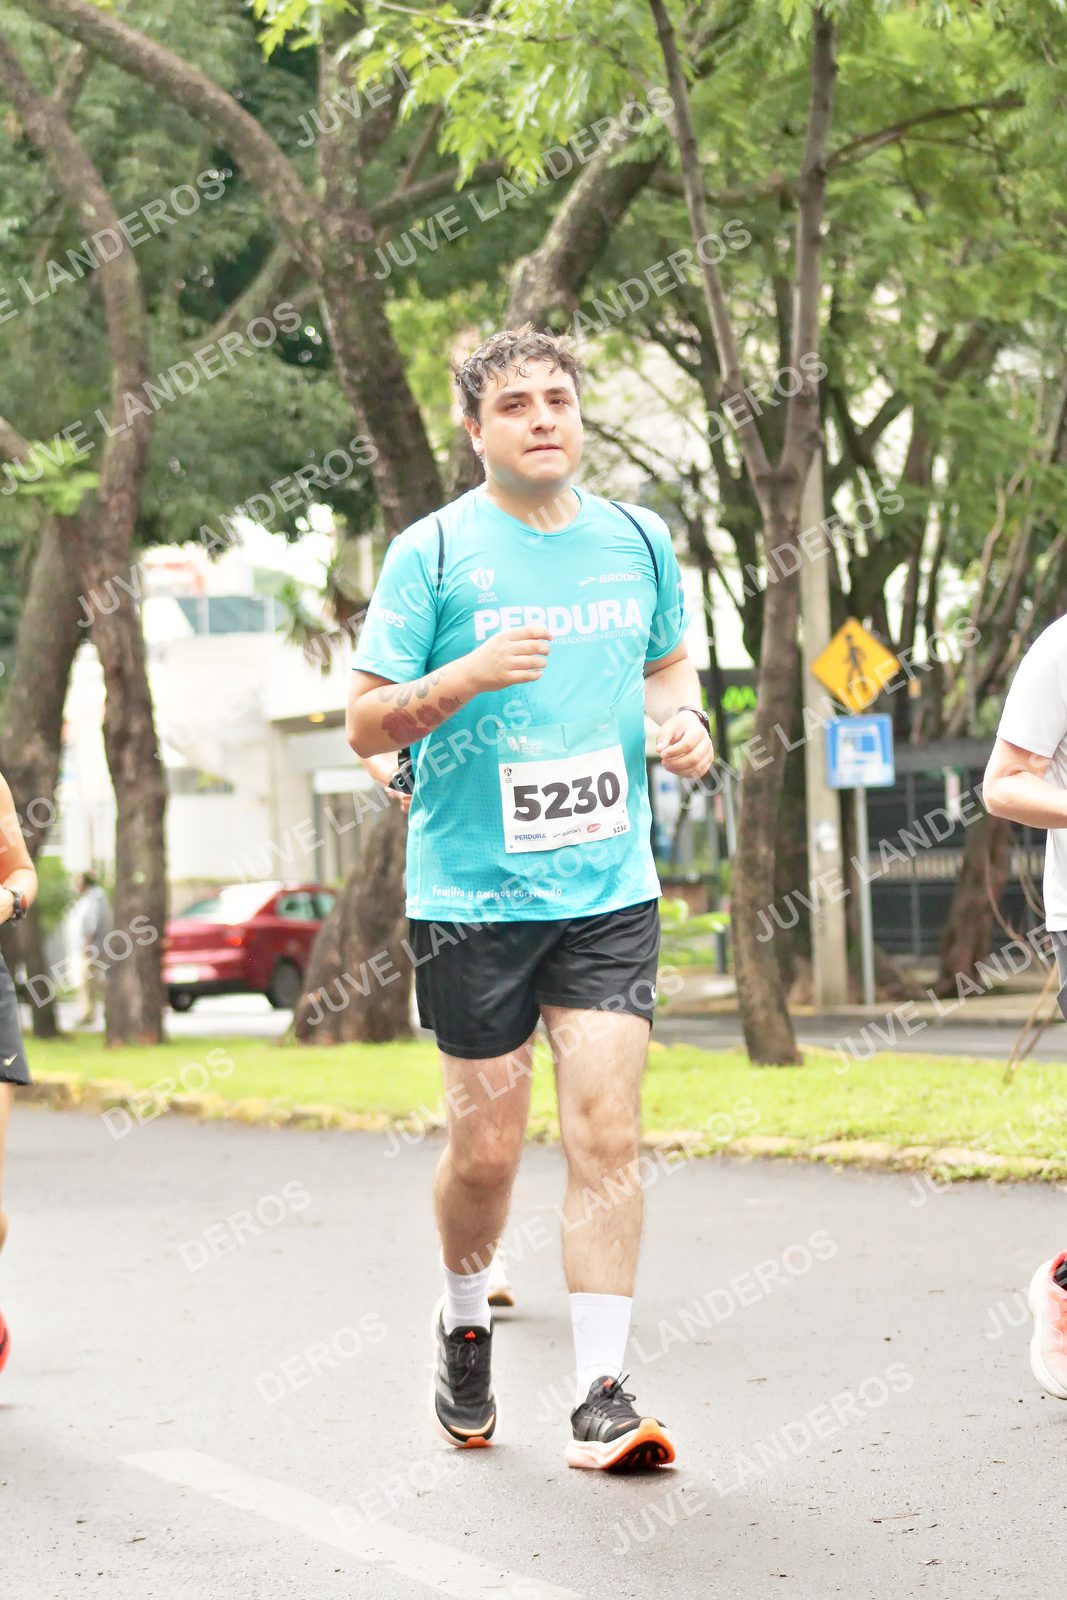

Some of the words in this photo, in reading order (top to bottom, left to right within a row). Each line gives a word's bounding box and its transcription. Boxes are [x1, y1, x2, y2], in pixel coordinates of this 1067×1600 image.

[474, 598, 643, 640] PERDURA
[513, 771, 621, 822] 5230
[514, 833, 546, 841] PERDURA
[432, 884, 465, 897] familia
[468, 890, 474, 900] y
[476, 889, 511, 900] amigos
[513, 887, 562, 898] corriendo
